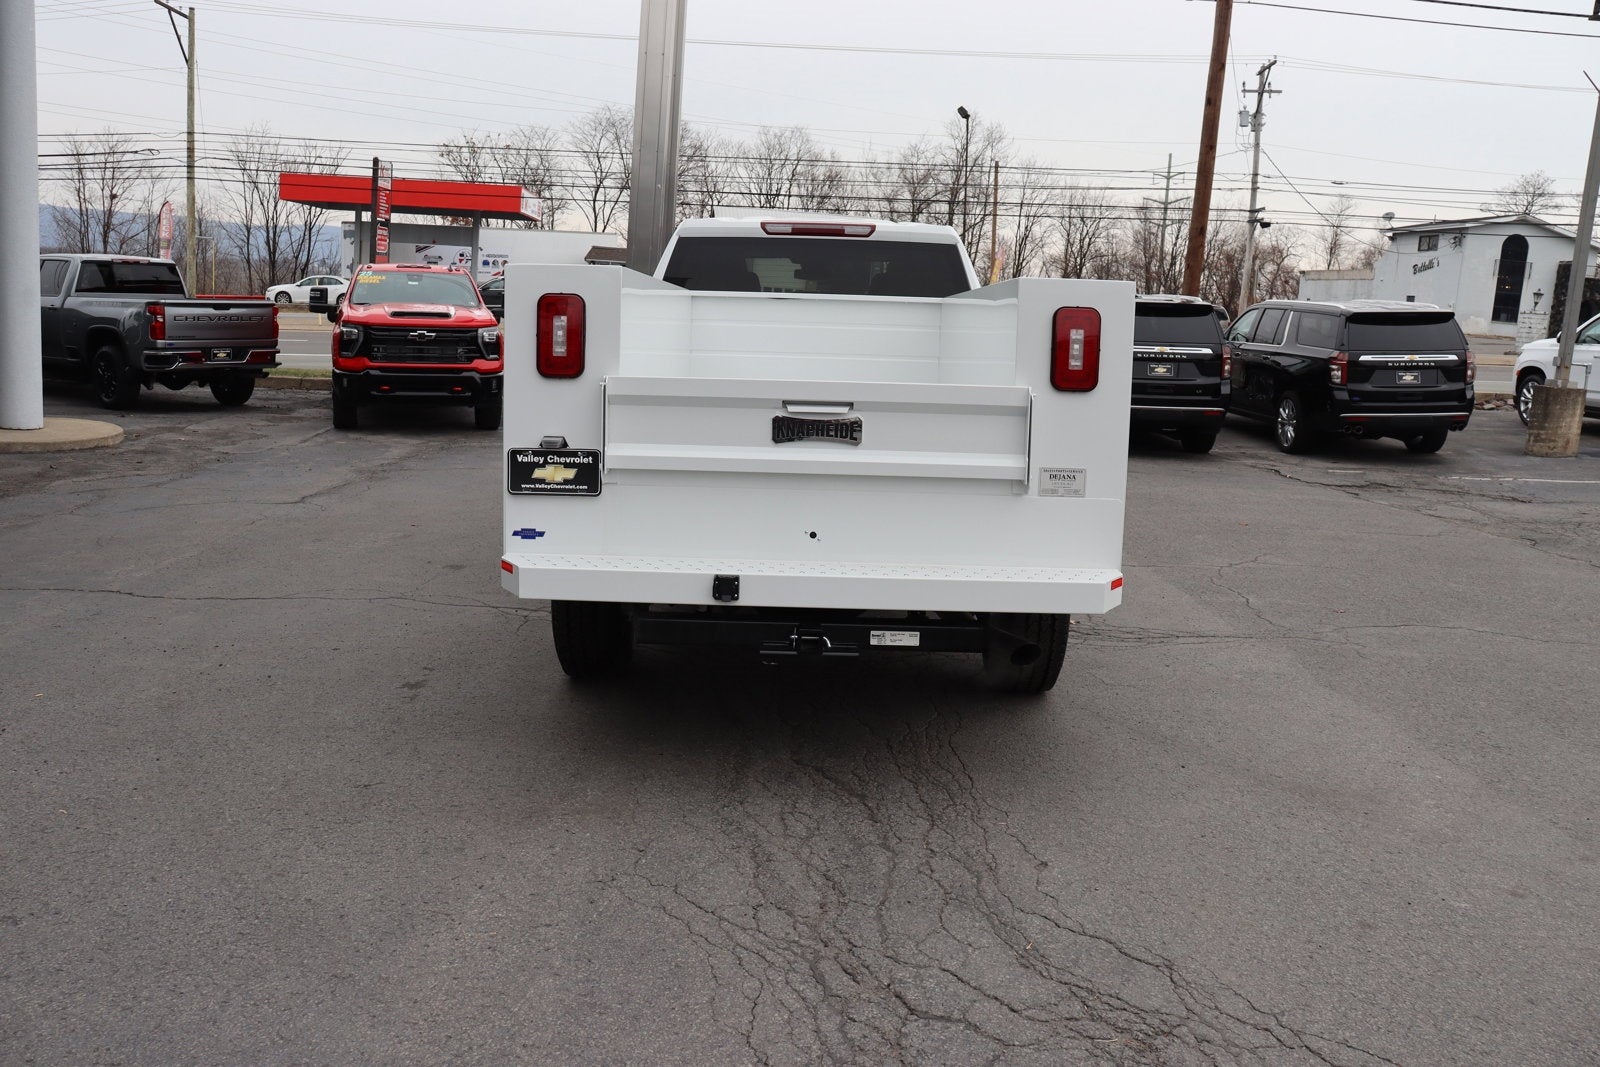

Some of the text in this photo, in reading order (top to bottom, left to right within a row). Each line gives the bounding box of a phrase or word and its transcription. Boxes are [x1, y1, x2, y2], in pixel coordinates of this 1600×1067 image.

[776, 420, 860, 441] KNAPHEIDE
[516, 454, 593, 464] Valley Chevrolet
